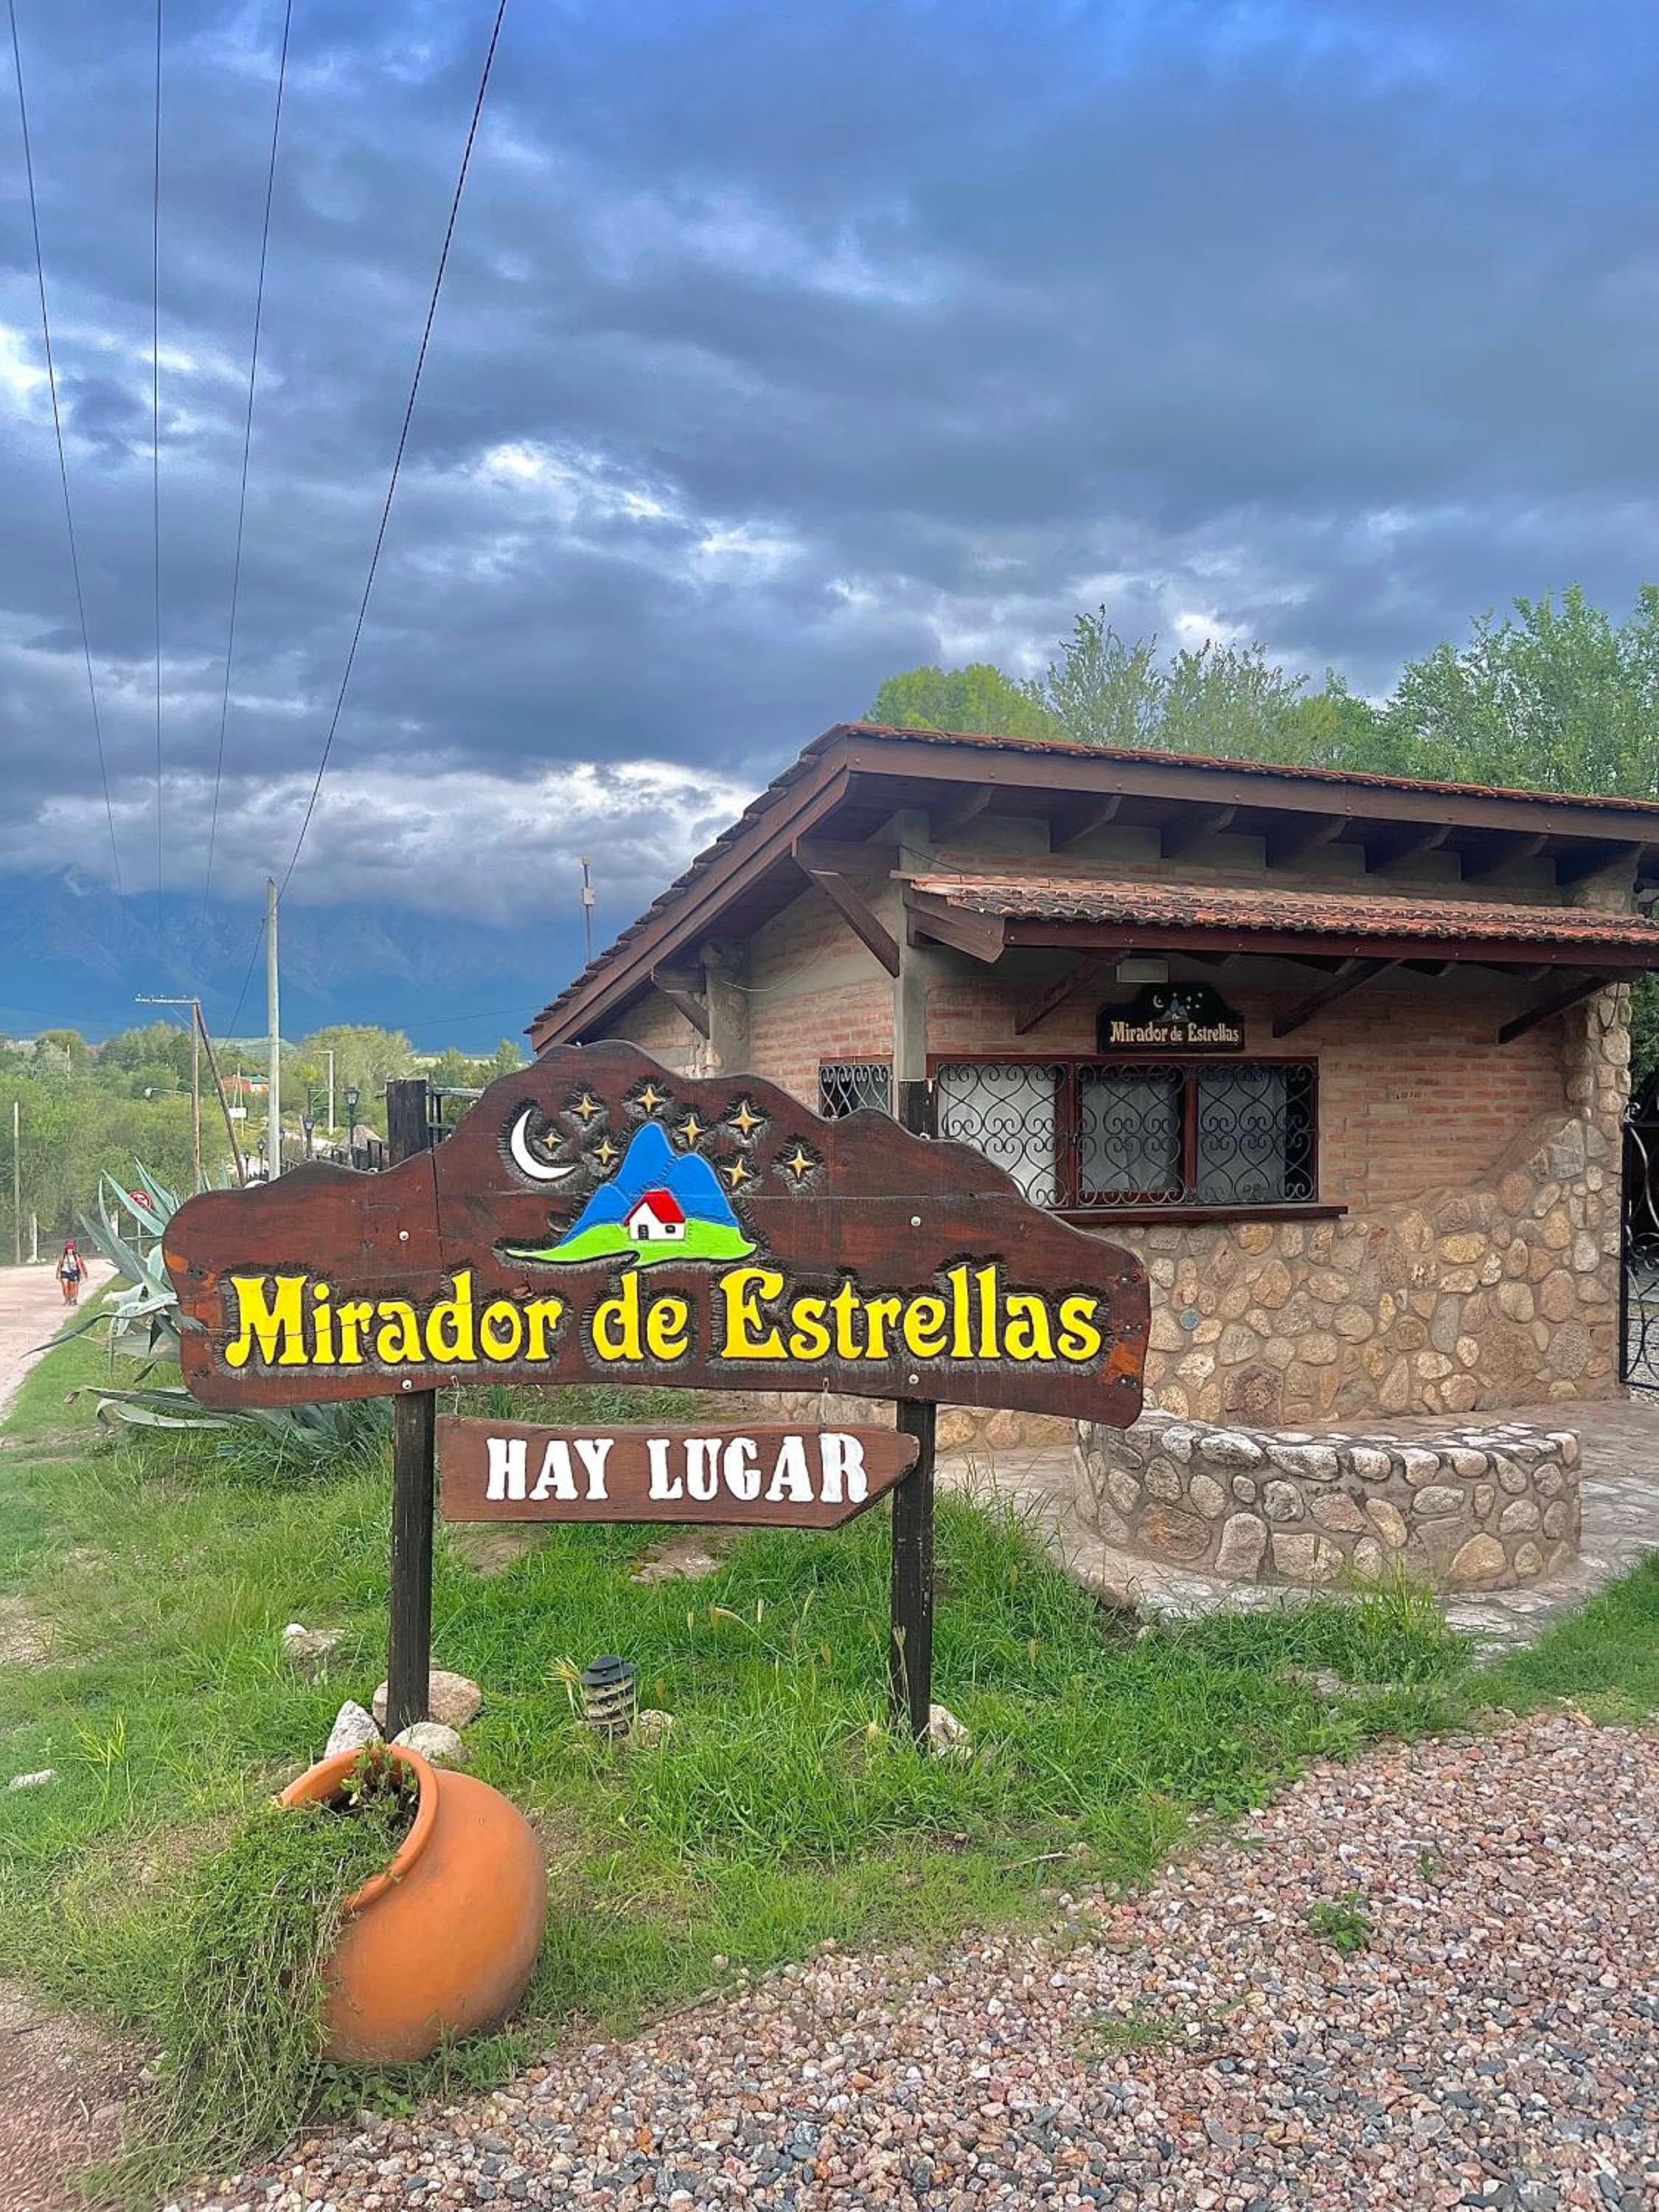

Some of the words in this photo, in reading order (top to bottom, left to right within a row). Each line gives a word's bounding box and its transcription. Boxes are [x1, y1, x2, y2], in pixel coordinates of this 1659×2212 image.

[1110, 1021, 1168, 1043] Mirador
[1170, 1026, 1183, 1042] de
[1188, 1023, 1239, 1043] Estrellas
[225, 1270, 563, 1366] Mirador
[592, 1271, 688, 1360] de
[719, 1265, 1103, 1362] Estrellas
[485, 1438, 613, 1500] HAY
[647, 1433, 869, 1503] LUGAR
